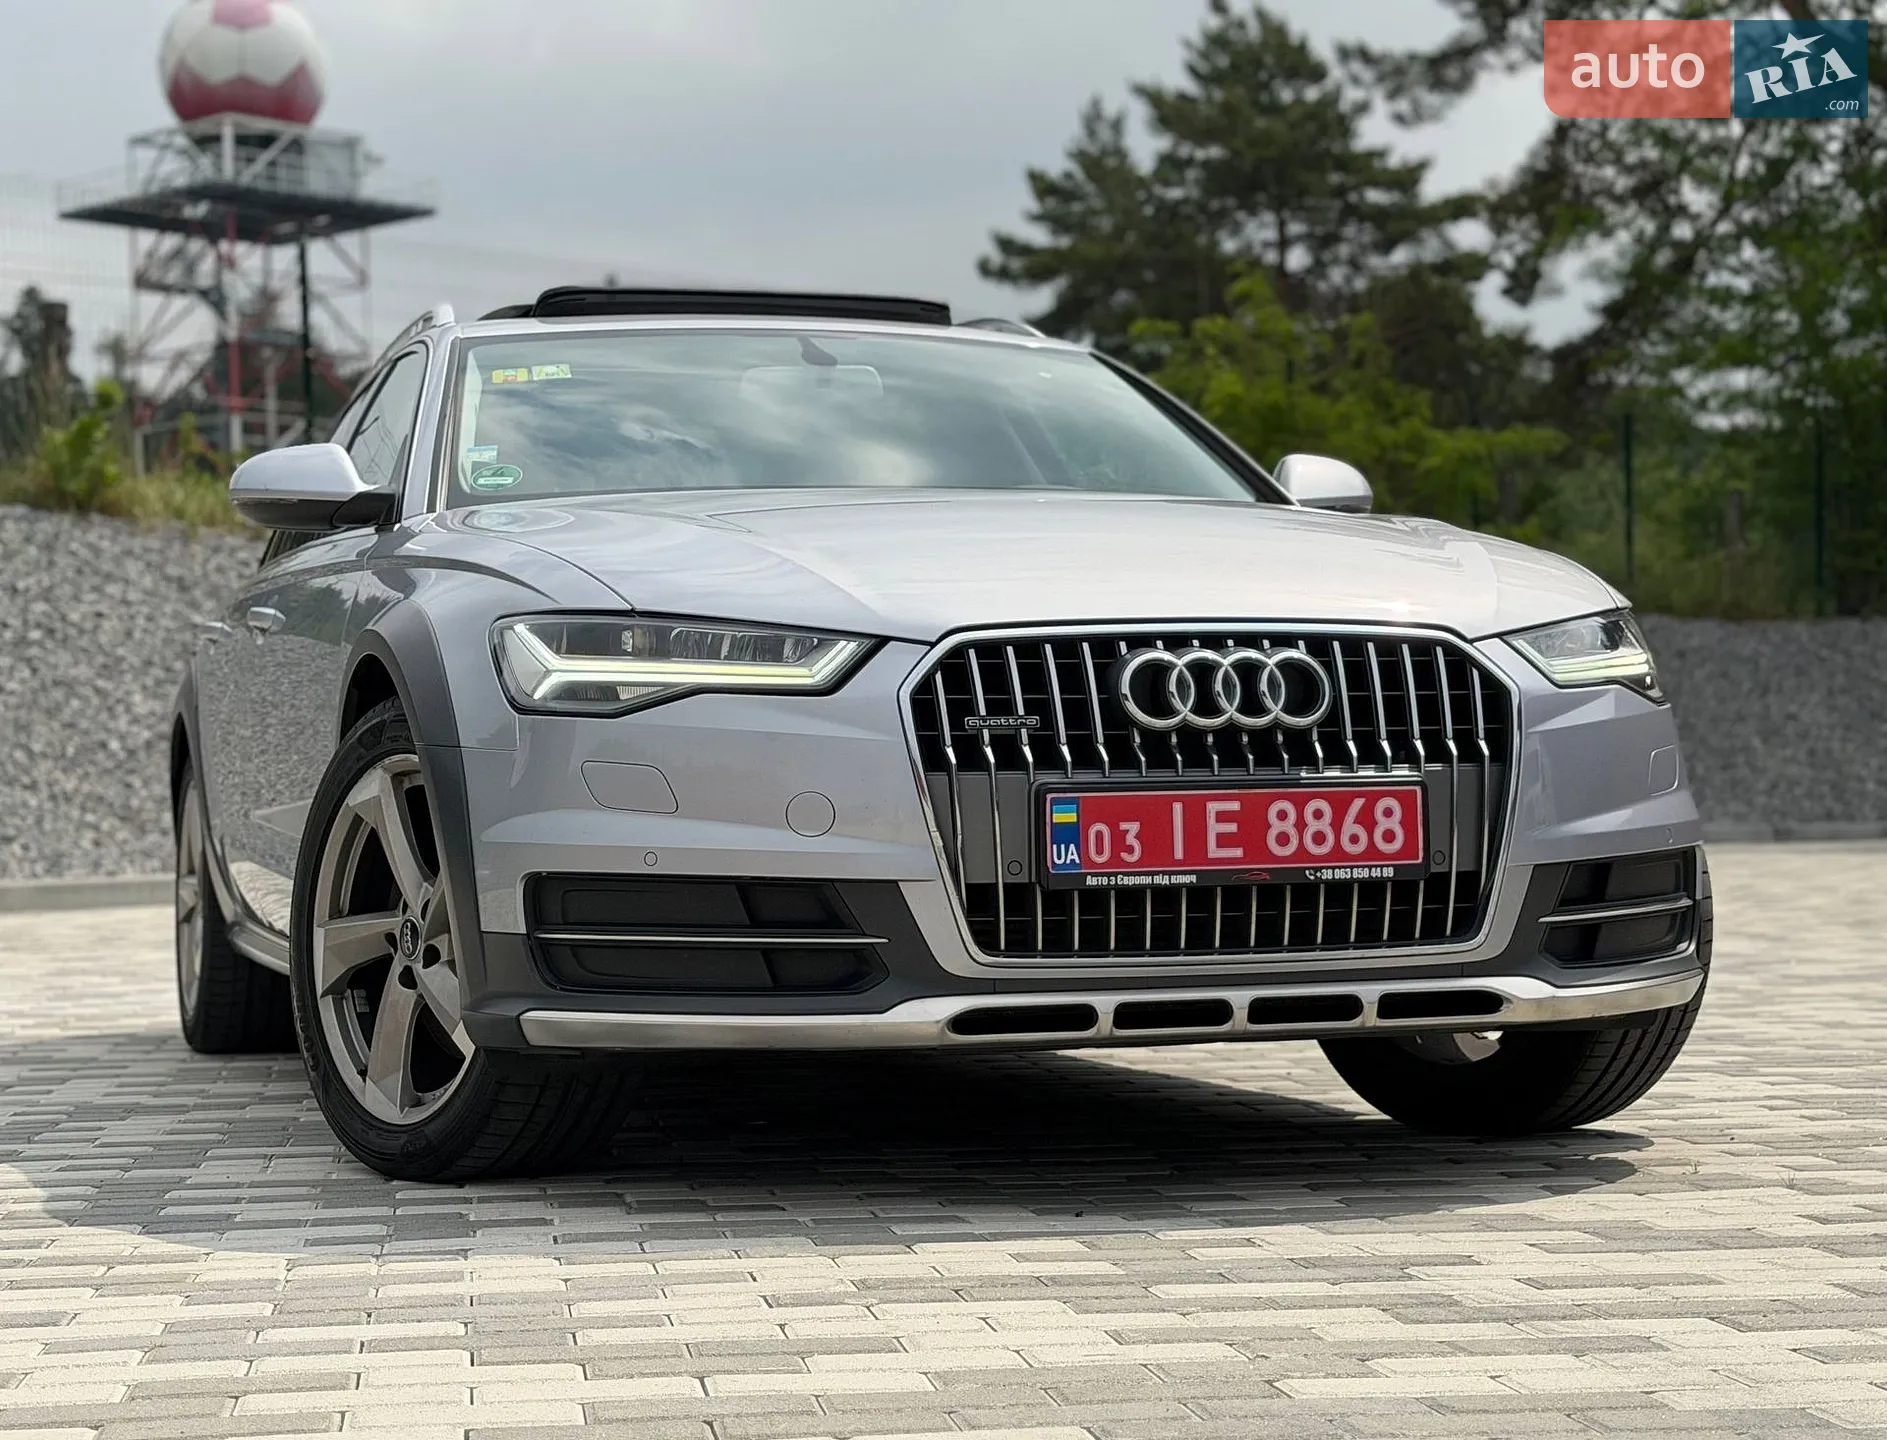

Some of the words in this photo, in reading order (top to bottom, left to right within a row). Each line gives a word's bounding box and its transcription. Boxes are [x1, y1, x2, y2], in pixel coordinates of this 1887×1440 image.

[968, 719, 1037, 728] quattro
[1087, 821, 1142, 864] 03
[1266, 797, 1405, 857] 8868
[1052, 844, 1080, 865] UA
[1086, 875, 1109, 886] Авто
[1109, 876, 1116, 885] з
[1117, 874, 1152, 886] Європи
[1153, 873, 1170, 885] під
[1171, 874, 1197, 884] ключ
[1316, 869, 1333, 879] +38
[1334, 868, 1351, 879] 063
[1370, 867, 1382, 878] 44
